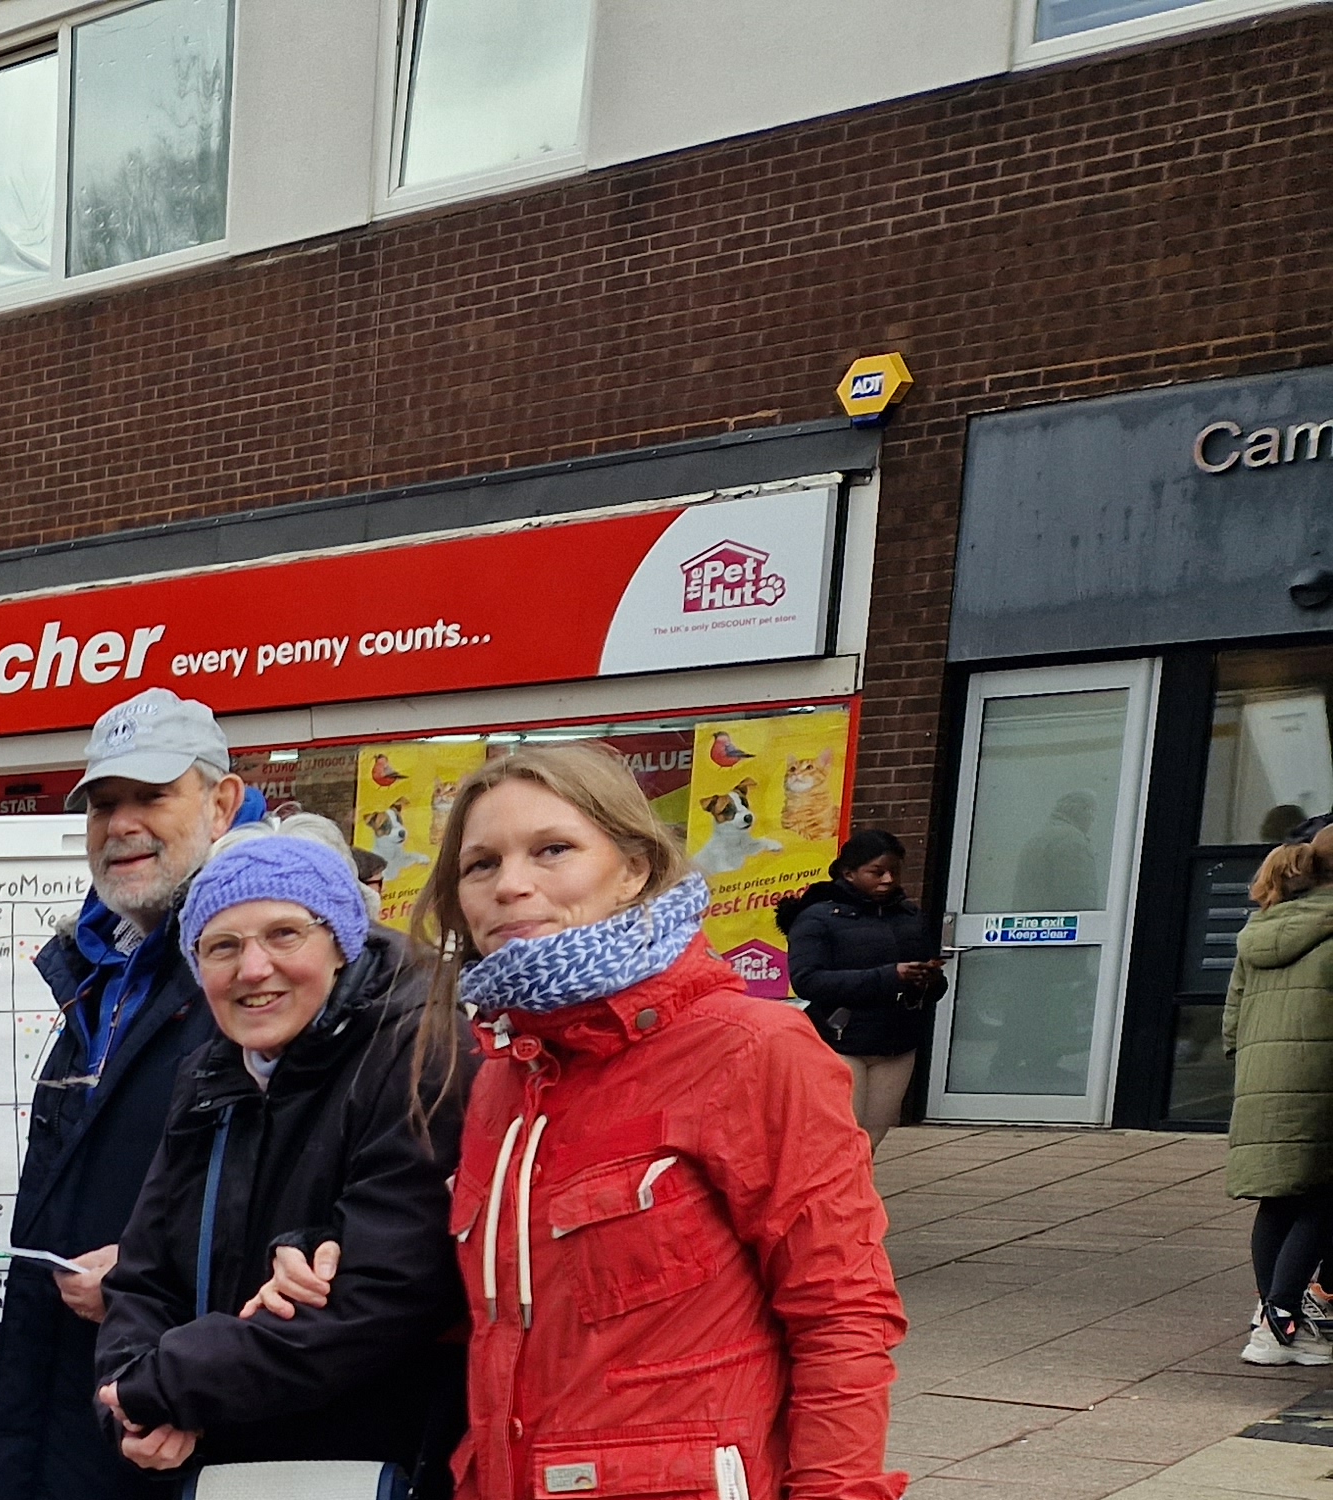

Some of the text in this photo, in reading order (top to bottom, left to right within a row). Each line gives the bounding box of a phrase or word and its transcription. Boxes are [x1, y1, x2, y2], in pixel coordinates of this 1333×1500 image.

[851, 374, 884, 398] ADT
[686, 557, 757, 601] the Pet
[701, 580, 756, 610] Hut
[653, 627, 668, 635] The
[691, 622, 709, 632] only
[711, 617, 757, 629] DISCOUNT
[758, 615, 773, 626] pet
[774, 613, 797, 623] store
[171, 647, 248, 678] every
[257, 635, 350, 675] penny
[0, 800, 37, 814] STAR
[719, 881, 742, 894] best
[743, 876, 776, 891] prices
[778, 873, 794, 885] for
[795, 867, 822, 882] your
[1014, 917, 1065, 928] Fire exit
[1008, 929, 1068, 941] Keep clear
[0, 943, 11, 958] in
[740, 955, 768, 971] Pet
